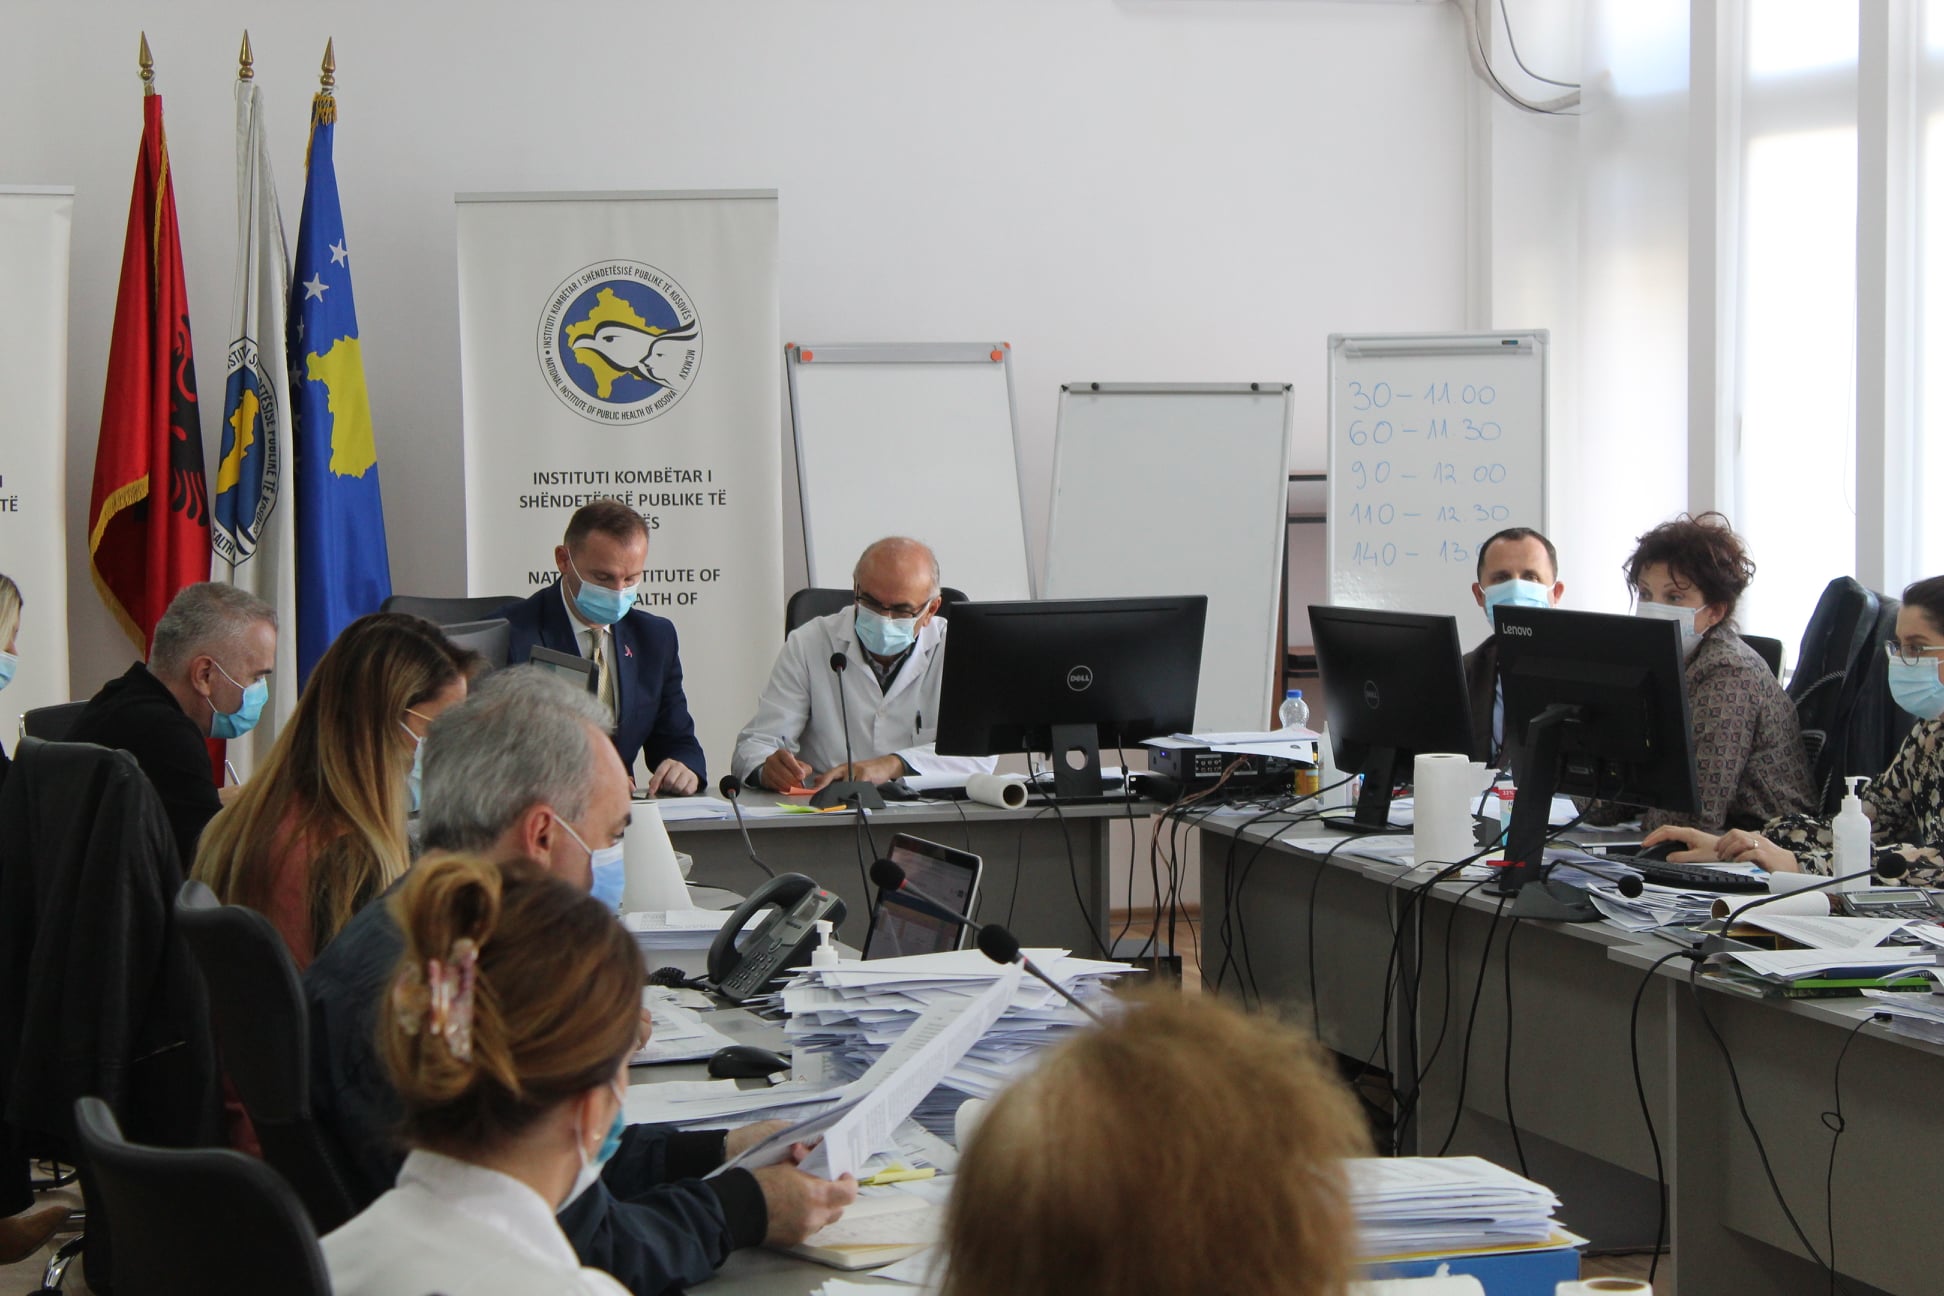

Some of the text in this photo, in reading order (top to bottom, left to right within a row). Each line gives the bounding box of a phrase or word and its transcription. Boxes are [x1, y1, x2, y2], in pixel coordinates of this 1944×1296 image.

[543, 313, 556, 349] INSTITUTI
[551, 282, 579, 315] KOMBËTAR
[634, 268, 664, 287] PUBLIKE
[679, 349, 696, 381] MCMXXV
[545, 357, 678, 421] NATIONAL INSTITUTE OF PUBLIC HEALTH OF KOSOVA
[1349, 381, 1392, 411] 30
[1349, 420, 1393, 446] 60
[533, 467, 712, 485] INSTITUTI KOMBËTAR I
[1351, 460, 1391, 490] 90
[638, 493, 704, 507] PUBLIKE
[708, 489, 727, 505] TË
[1350, 503, 1395, 525] 110
[1353, 541, 1397, 566] 140
[642, 568, 721, 583] TITUTE OF
[633, 592, 698, 606] ALTH OF
[1502, 622, 1533, 637] Lenovo
[1070, 674, 1090, 682] DELL
